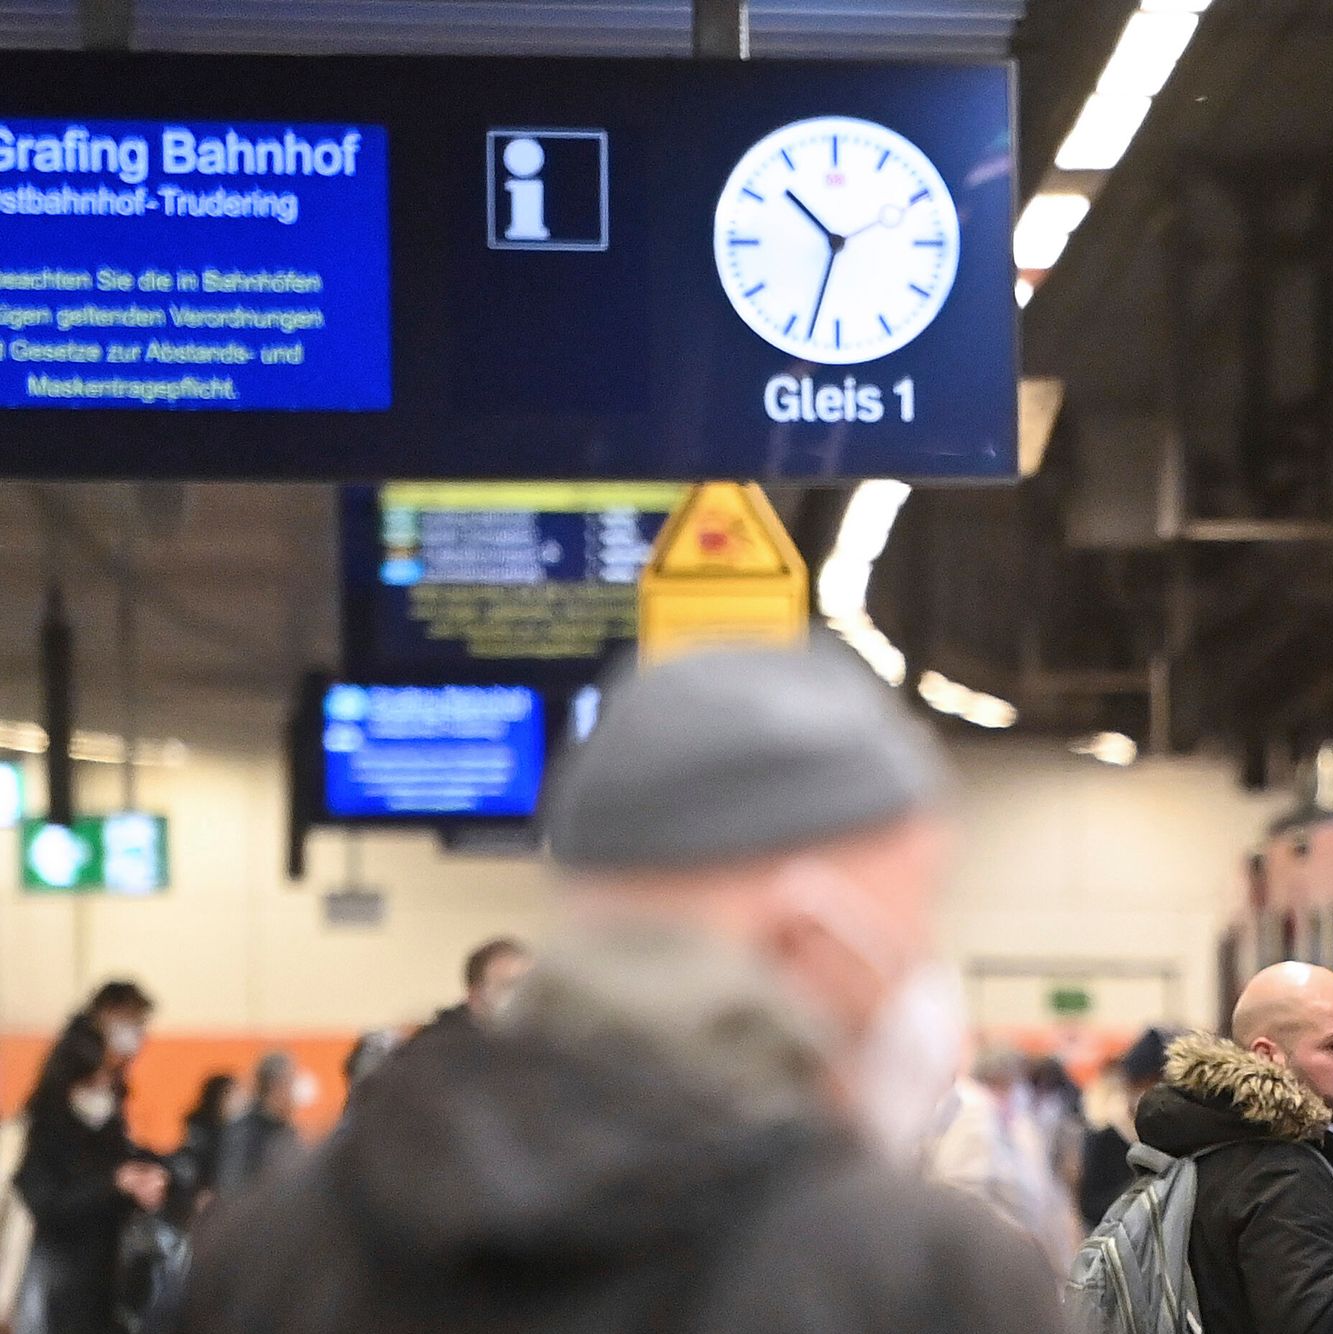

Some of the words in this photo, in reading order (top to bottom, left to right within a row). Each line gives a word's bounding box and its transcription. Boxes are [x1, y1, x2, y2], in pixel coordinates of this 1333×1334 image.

[0, 127, 148, 183] Grafing
[162, 127, 361, 177] Bahnhof
[97, 268, 133, 291] Sie
[138, 269, 172, 291] die
[177, 270, 198, 291] in
[57, 304, 166, 331] geltenden
[170, 303, 324, 333] Verordnungen
[10, 338, 101, 361] Gesetze
[107, 343, 140, 363] zur
[261, 343, 303, 364] und
[764, 374, 885, 423] Gleis
[893, 376, 915, 423] 1
